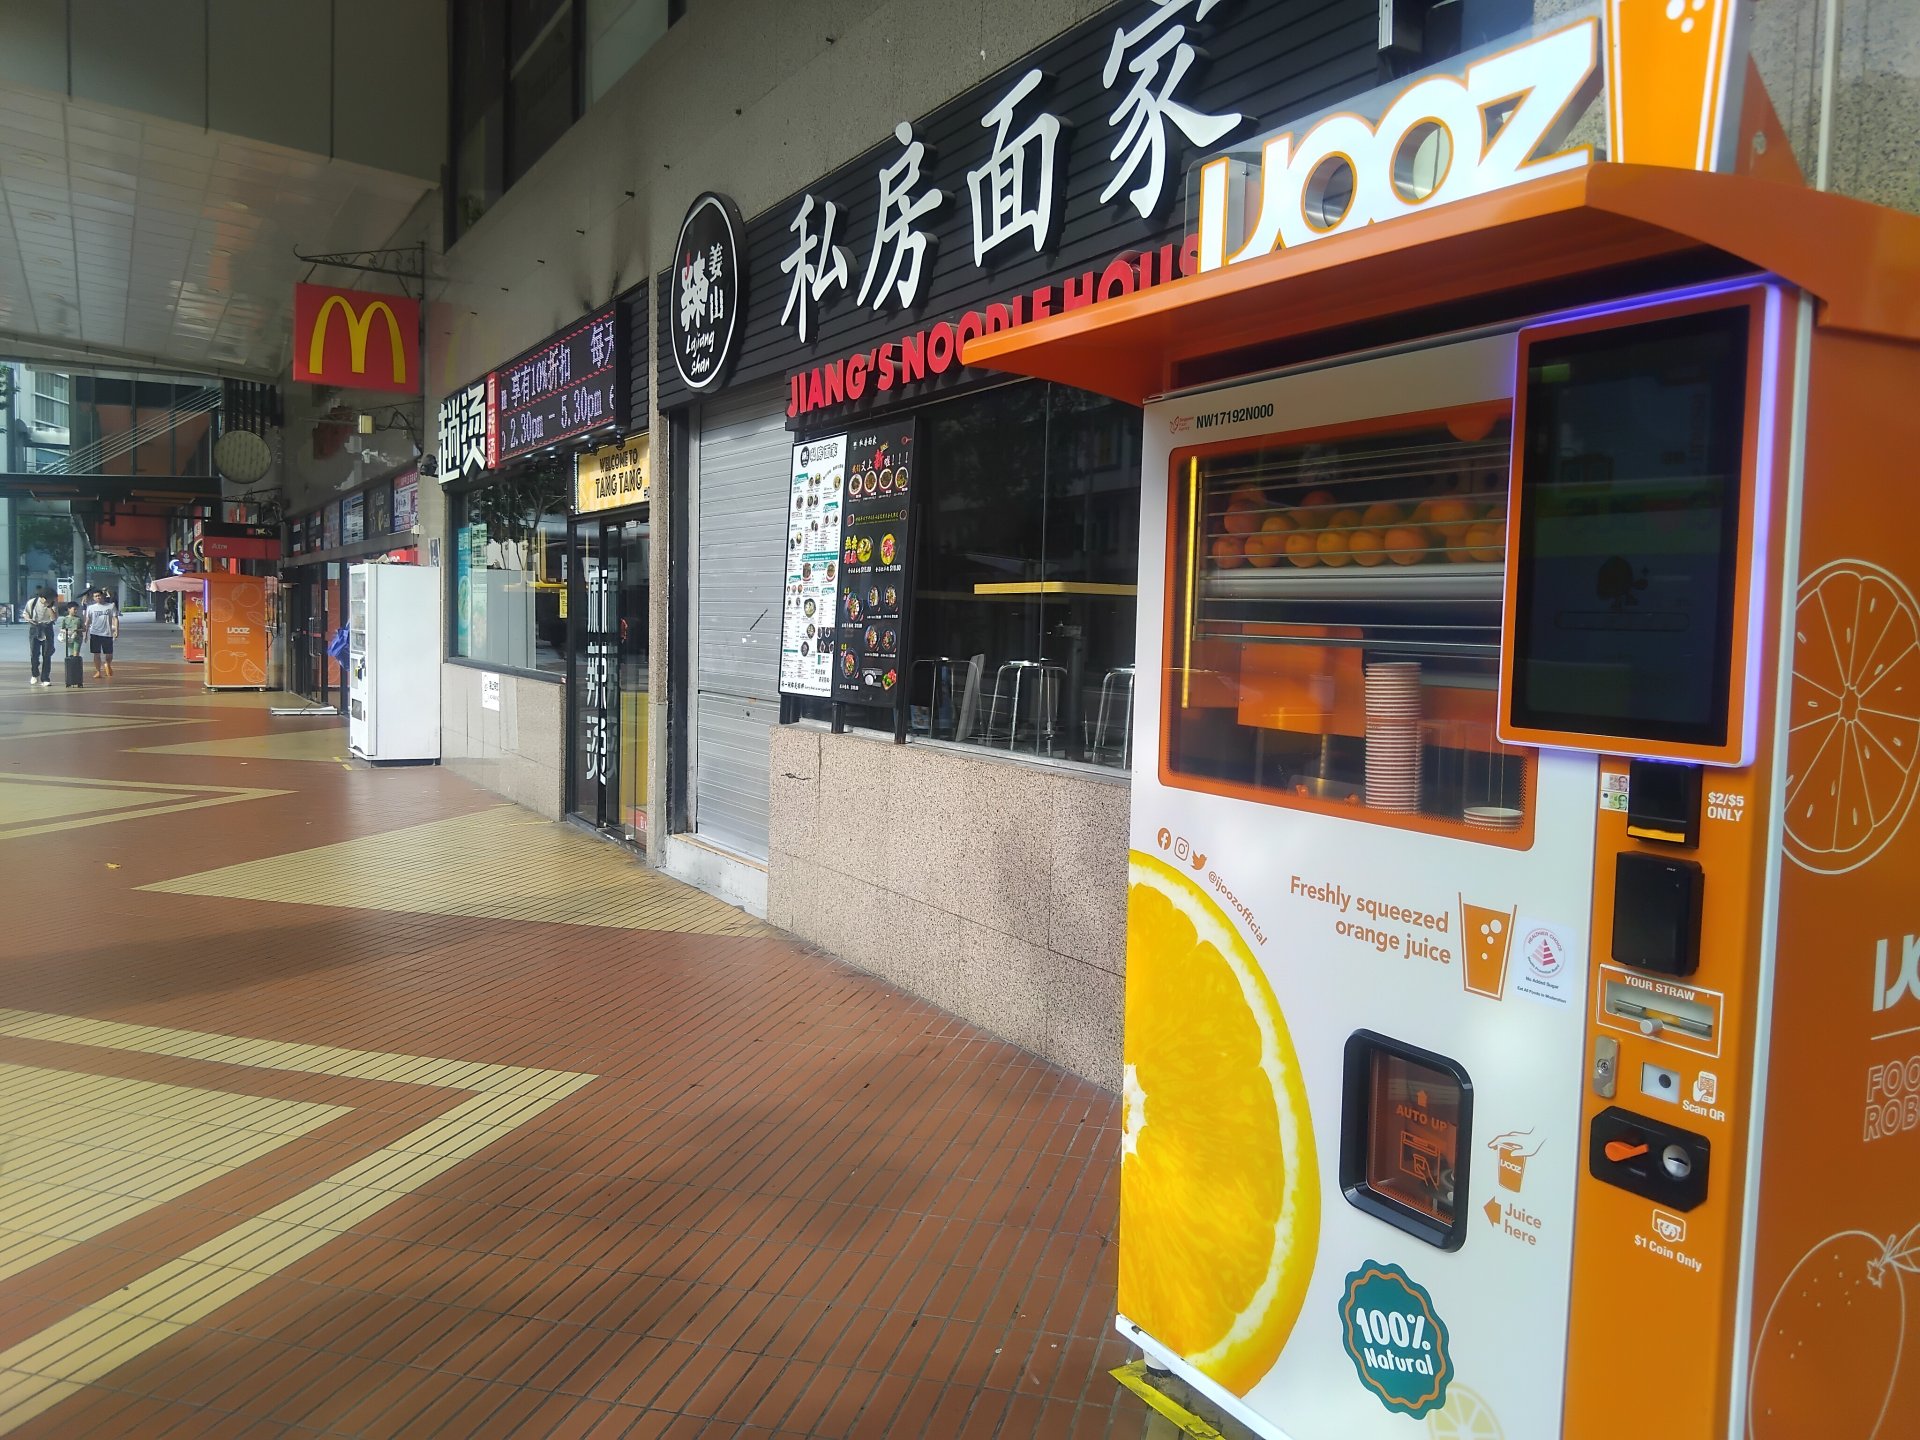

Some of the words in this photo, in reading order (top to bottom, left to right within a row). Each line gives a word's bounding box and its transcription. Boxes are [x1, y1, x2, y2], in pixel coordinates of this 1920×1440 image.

[787, 343, 893, 417] JIANG'S
[1196, 403, 1274, 429] NW17192N000
[600, 451, 628, 473] WELCOME
[629, 448, 638, 465] TO
[596, 474, 617, 498] TANG
[619, 468, 643, 493] TANG
[1708, 792, 1744, 807] $2/$5
[1707, 806, 1743, 822] ONLY
[1208, 871, 1268, 946] @ijoozofficial
[1290, 875, 1351, 913] Freshly
[1356, 897, 1449, 933] squeezed
[1335, 919, 1400, 952] orange
[1404, 933, 1451, 964] juice
[1624, 975, 1653, 991] YOUR
[1656, 983, 1695, 1001] STRAW
[1396, 1104, 1427, 1125] AUTO
[1431, 1117, 1447, 1131] UP
[1682, 1099, 1708, 1117] Scan
[1709, 1107, 1726, 1122] QR
[1504, 1203, 1542, 1229] Juice
[1504, 1219, 1537, 1246] here
[1634, 1234, 1647, 1248] $1
[1649, 1240, 1674, 1259] Coin
[1676, 1252, 1702, 1273] Only
[1356, 1307, 1431, 1351] 100%
[1364, 1347, 1434, 1376] Natural
